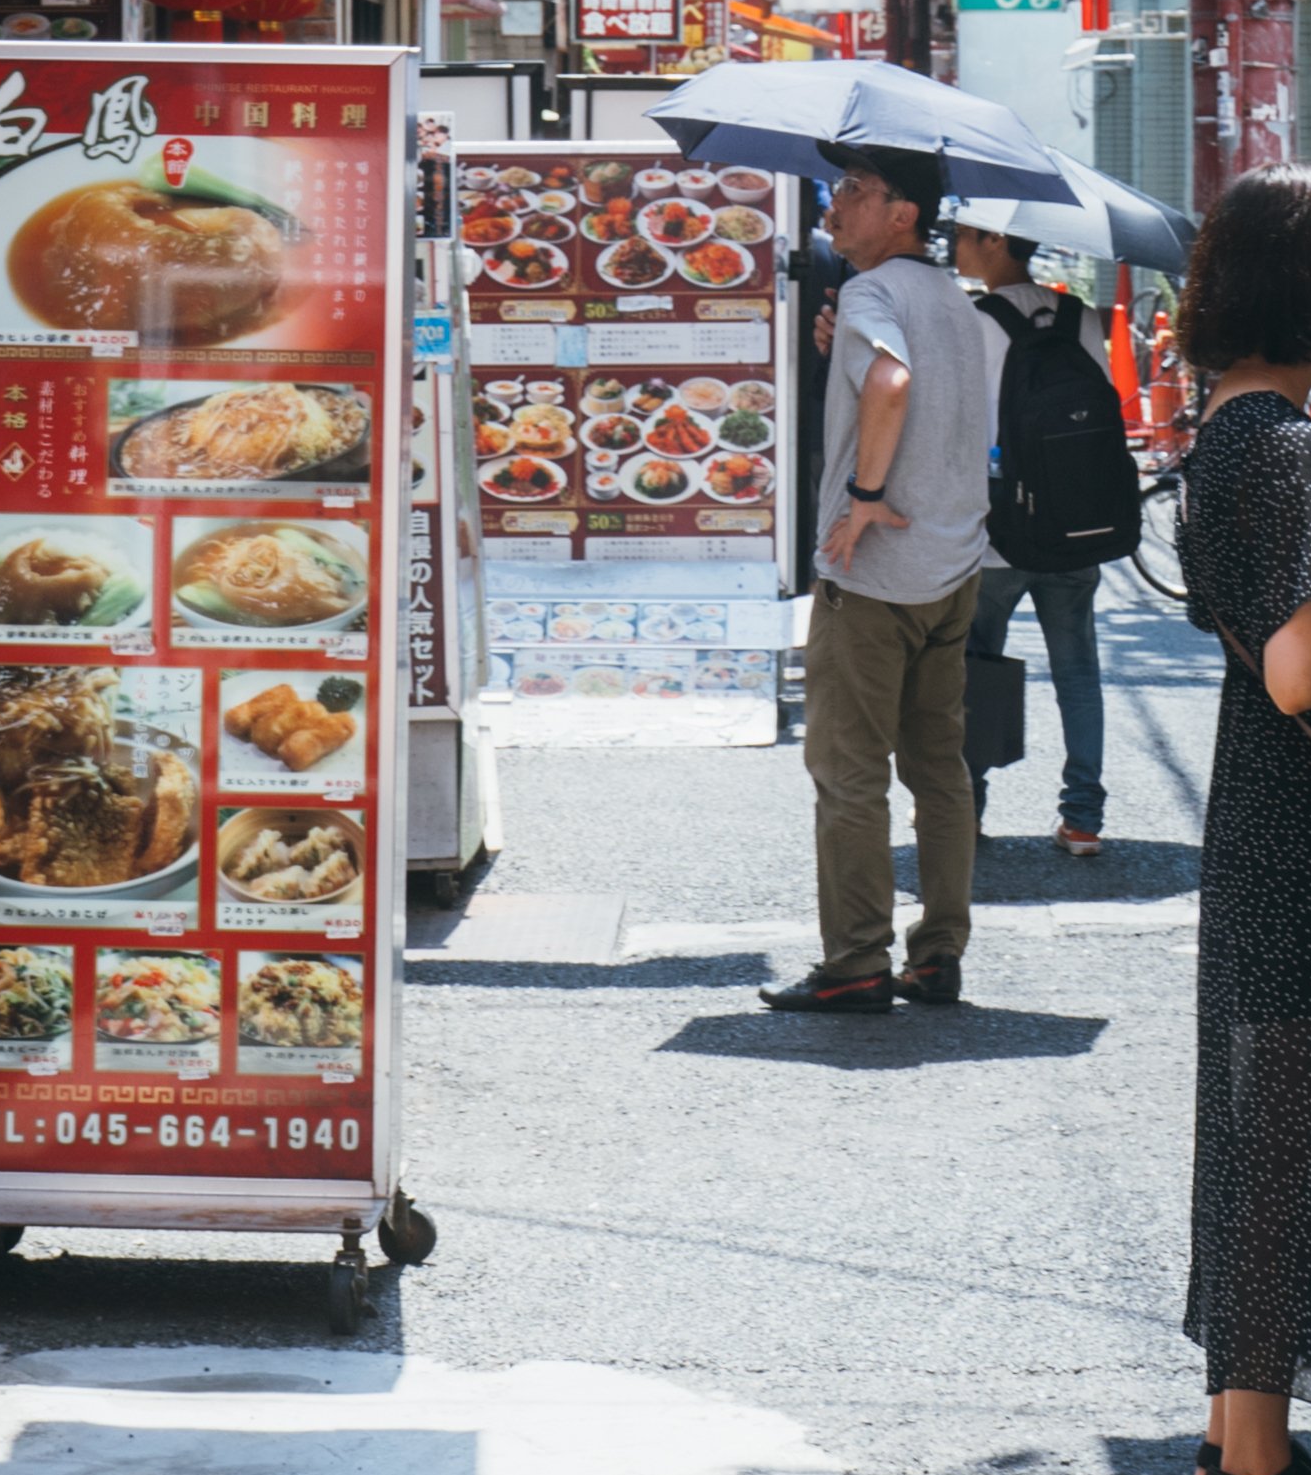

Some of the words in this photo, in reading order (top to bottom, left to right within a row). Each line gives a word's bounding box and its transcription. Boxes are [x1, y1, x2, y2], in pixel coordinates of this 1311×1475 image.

[581, 10, 674, 36] 食べ放題
[246, 83, 319, 94] RESTAURANT
[194, 99, 368, 129] 中国料理
[1, 384, 29, 429] 本格
[38, 380, 55, 499] 素材にこだわる
[67, 383, 88, 485] おすすめ料理
[409, 509, 435, 704] 自慢の人気セット
